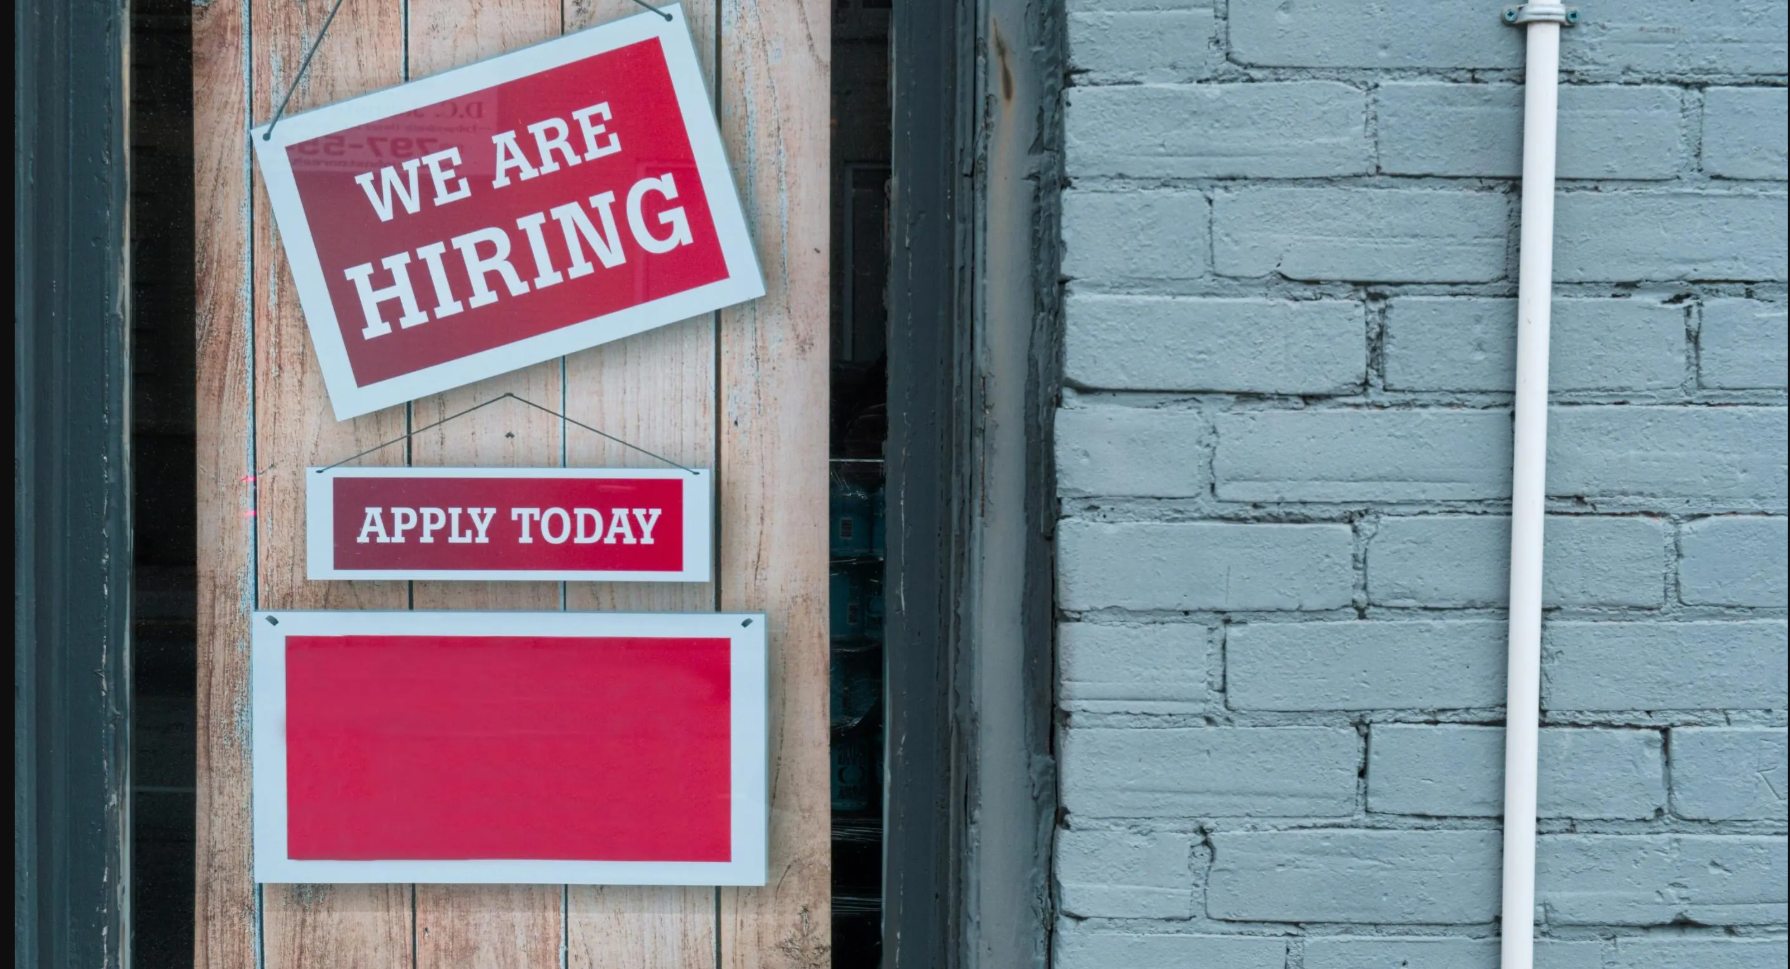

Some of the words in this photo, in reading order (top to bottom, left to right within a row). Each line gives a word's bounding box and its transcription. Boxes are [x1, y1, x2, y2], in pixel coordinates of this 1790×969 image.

[355, 147, 472, 222] WE
[492, 102, 622, 189] ARE
[344, 173, 694, 340] HIRING
[357, 507, 497, 544] APPLY
[511, 508, 662, 545] TODAY
